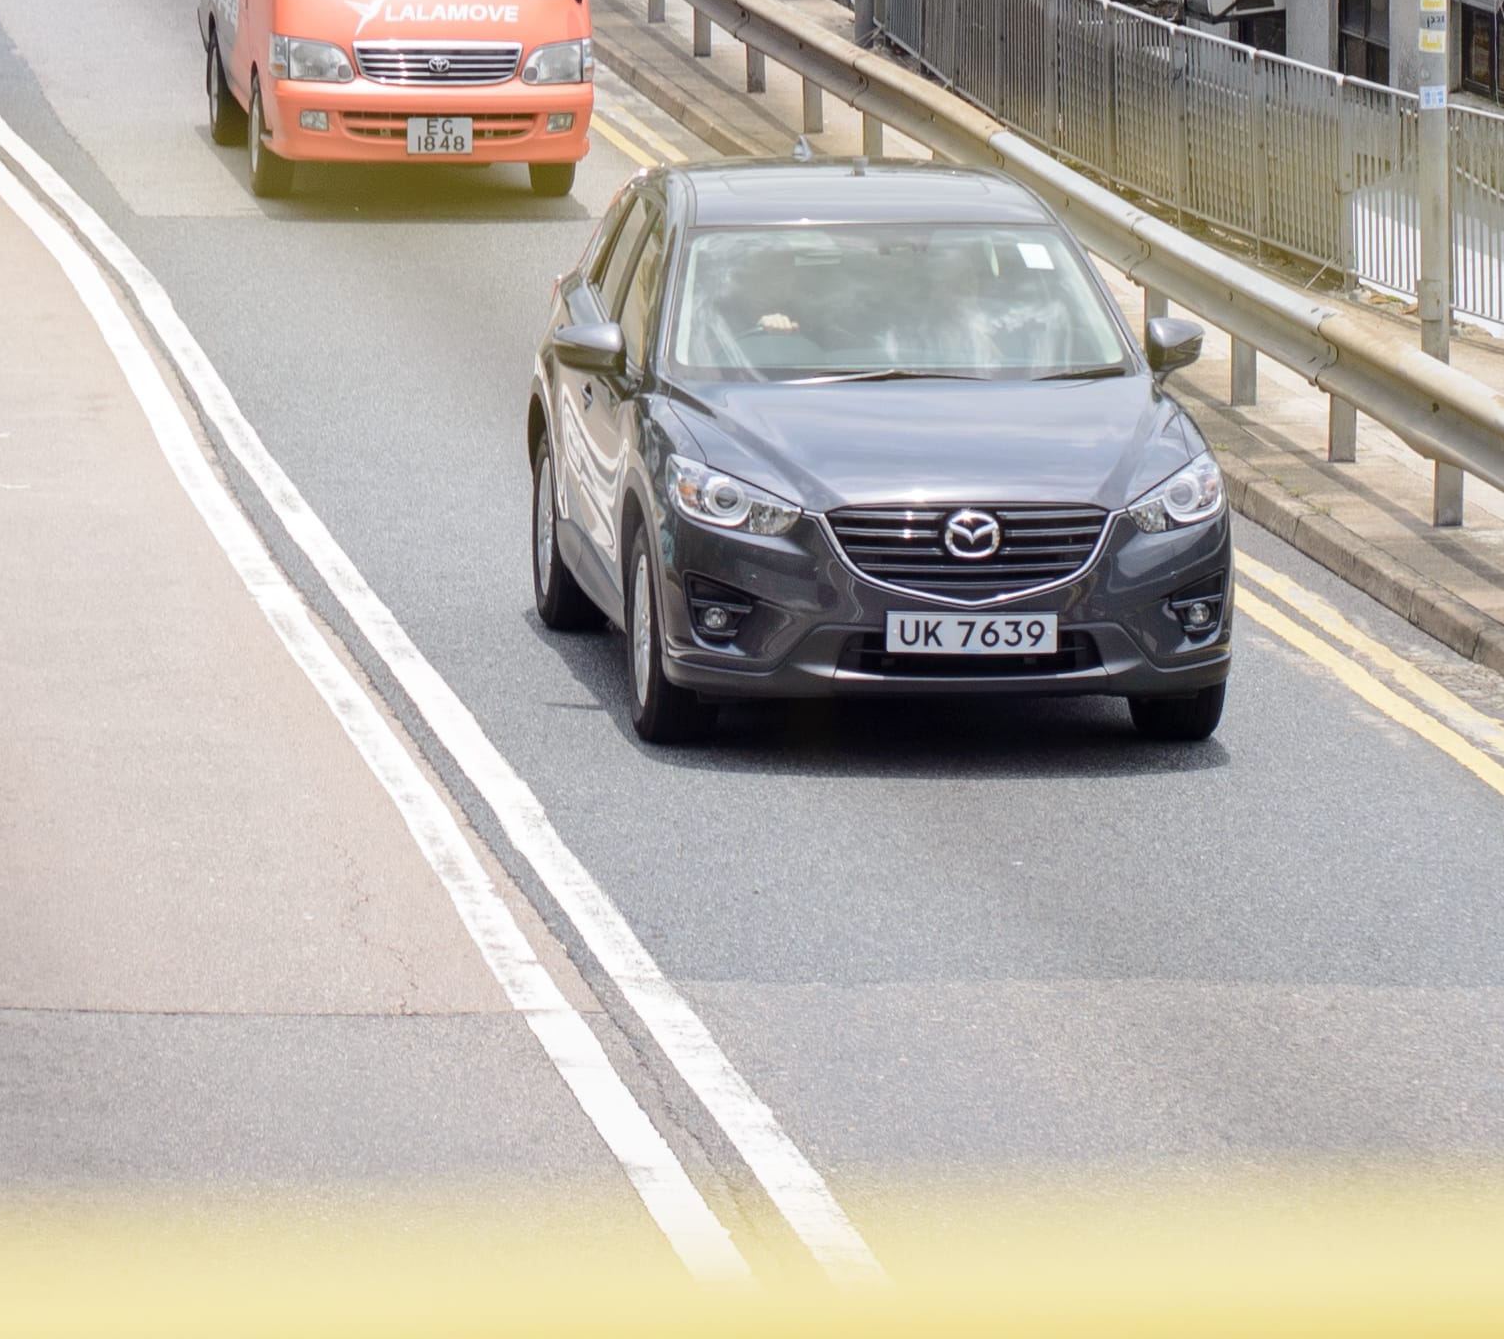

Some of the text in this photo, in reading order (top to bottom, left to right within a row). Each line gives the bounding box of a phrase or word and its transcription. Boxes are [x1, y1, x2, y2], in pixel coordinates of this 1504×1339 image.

[384, 3, 520, 22] LALAMOVE
[426, 119, 453, 135] EG
[417, 135, 464, 152] 1848
[899, 620, 1045, 648] UK 7639
